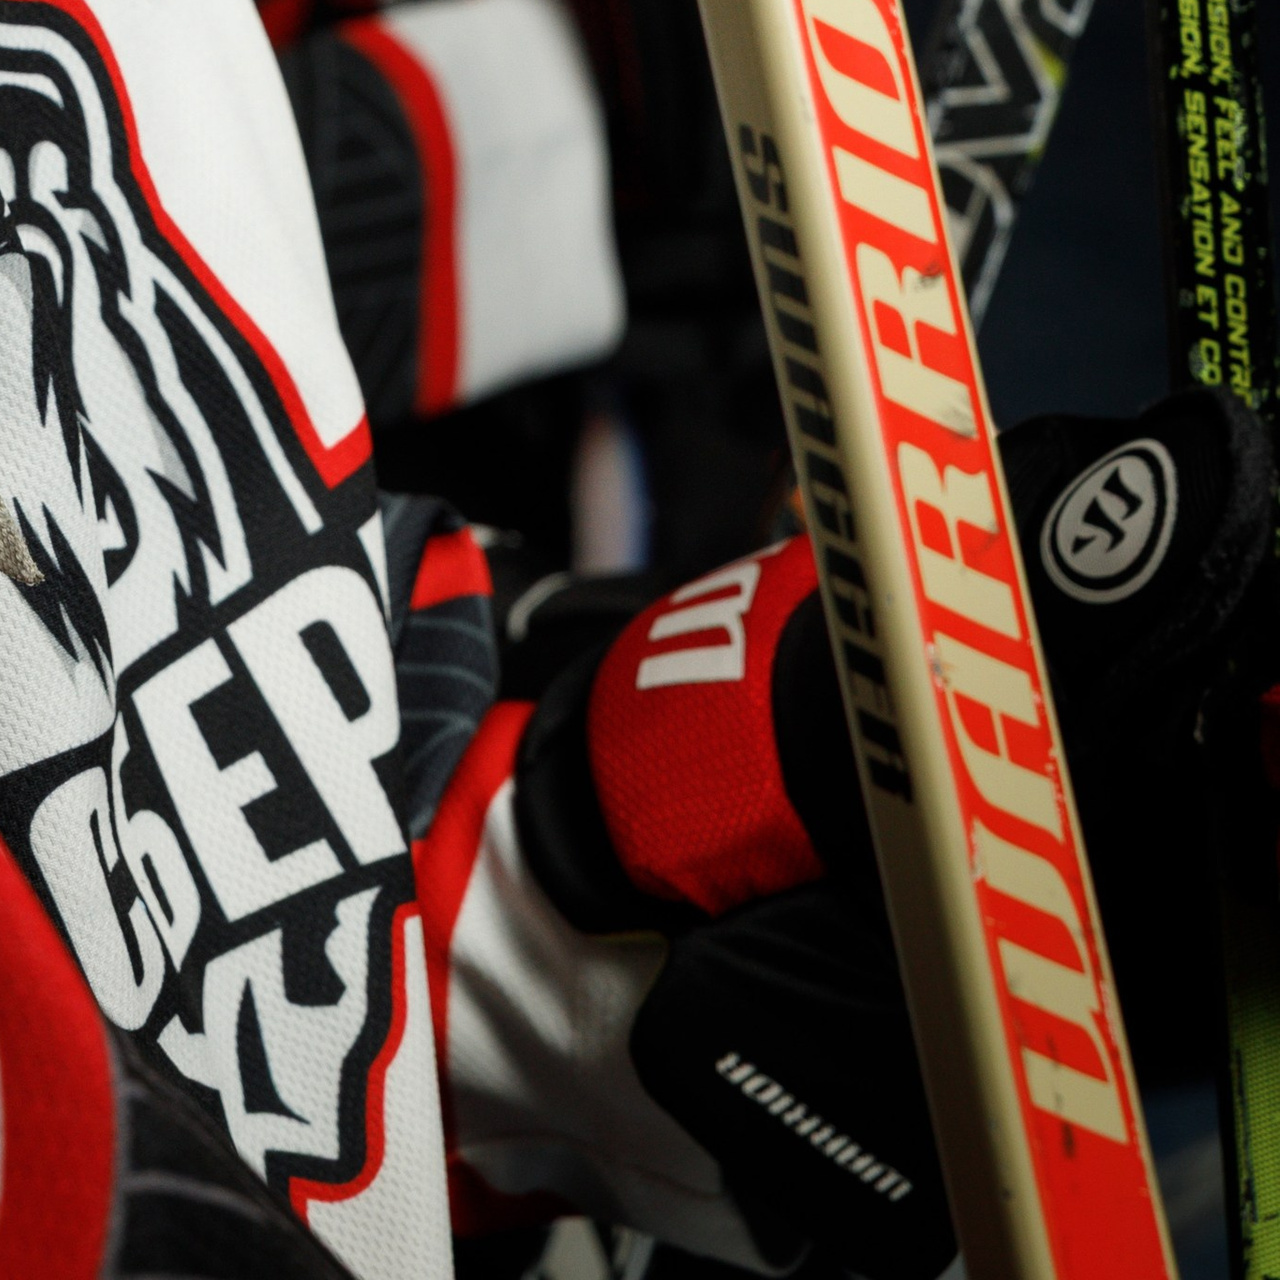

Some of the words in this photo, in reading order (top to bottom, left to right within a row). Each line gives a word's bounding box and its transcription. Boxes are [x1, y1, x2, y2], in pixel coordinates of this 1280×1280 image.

[1182, 88, 1216, 278] SENSATION
[1218, 191, 1245, 266] AND
[1195, 282, 1218, 330] ET
[714, 1050, 917, 1204] WARRIOR
